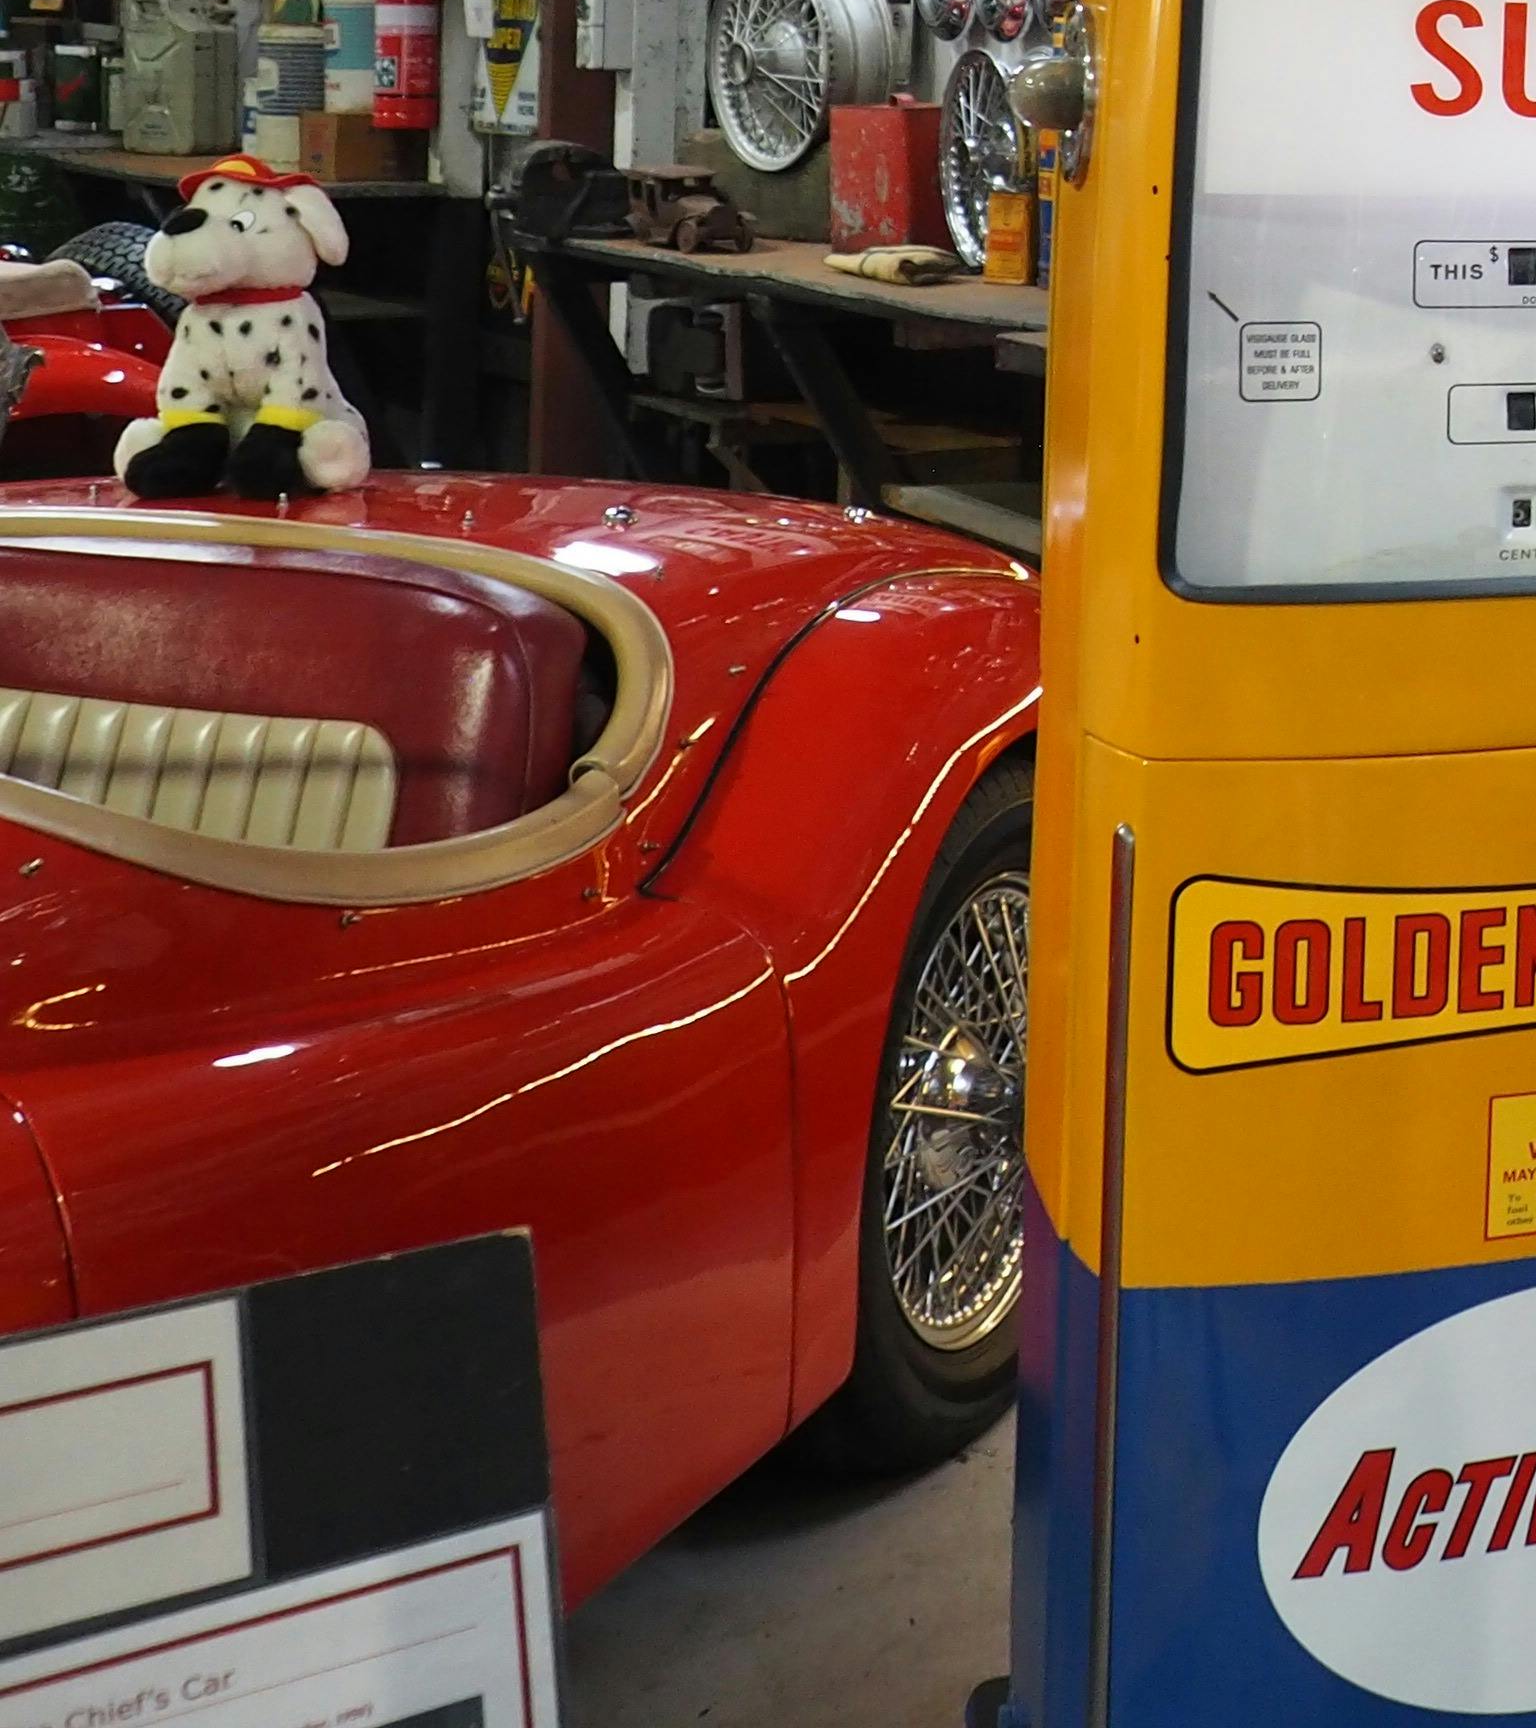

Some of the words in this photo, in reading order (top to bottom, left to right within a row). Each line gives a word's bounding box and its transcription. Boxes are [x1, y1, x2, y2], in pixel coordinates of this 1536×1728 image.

[1430, 264, 1483, 280] THIS
[1489, 245, 1499, 263] $
[1503, 1168, 1536, 1183] MAY
[65, 1686, 171, 1728] Chief's
[181, 1670, 235, 1702] Car
